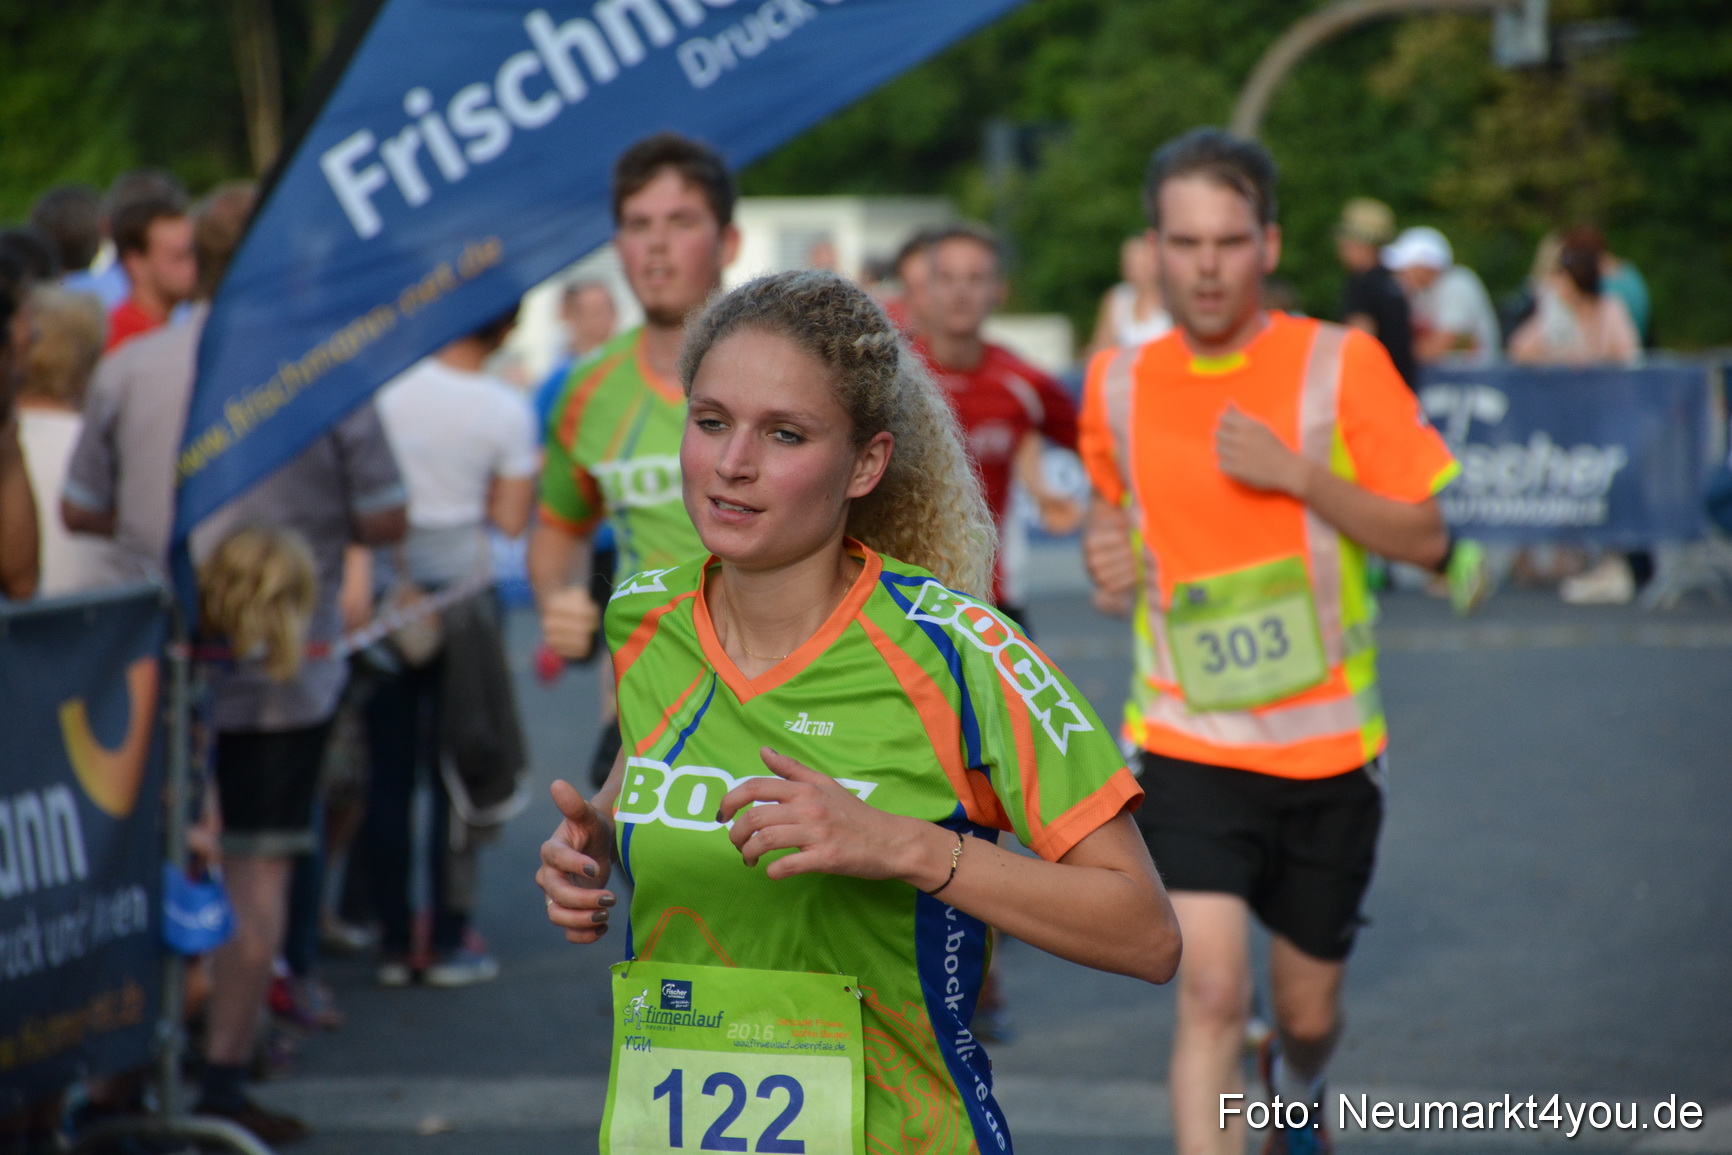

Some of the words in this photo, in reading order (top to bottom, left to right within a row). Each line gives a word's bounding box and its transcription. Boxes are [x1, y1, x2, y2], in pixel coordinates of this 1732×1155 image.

[319, 0, 740, 239] Frischm
[906, 579, 1094, 756] BOCK
[1197, 614, 1290, 676] 303
[614, 756, 878, 832] BO
[645, 1005, 725, 1028] firmenlauf
[645, 1023, 677, 1032] neumarkt
[726, 1022, 775, 1040] 2016
[652, 1067, 806, 1155] 122
